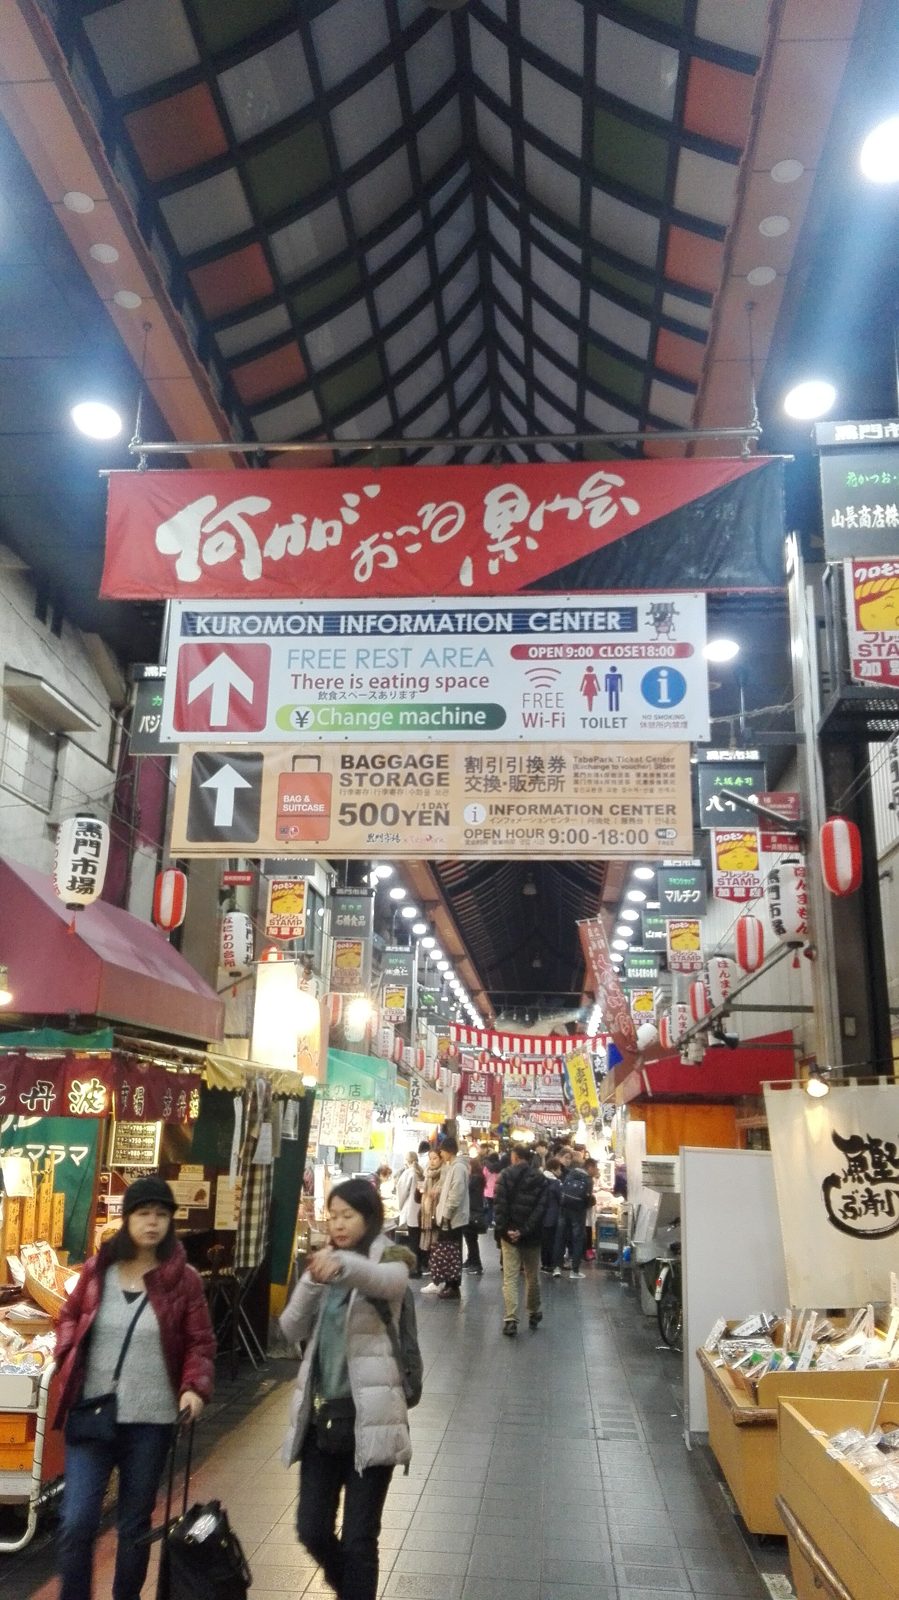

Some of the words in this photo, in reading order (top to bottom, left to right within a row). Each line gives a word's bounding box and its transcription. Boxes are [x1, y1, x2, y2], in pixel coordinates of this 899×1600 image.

[196, 615, 324, 635] KUROMON
[340, 612, 513, 635] INFORMATION
[528, 611, 621, 632] CENTER
[288, 648, 347, 669] FREE
[356, 648, 413, 669] REST
[420, 647, 494, 668] AREA
[528, 646, 562, 658] OPEN
[566, 646, 594, 658] 9:00
[291, 673, 344, 690] There
[350, 673, 363, 690] is
[368, 672, 430, 693] eating
[435, 676, 490, 692] space
[318, 691, 418, 701] 飲食スペースあります
[522, 692, 564, 709] FREE
[317, 707, 393, 730] Change
[399, 706, 487, 725] machine
[522, 711, 565, 728] Wi-Fi
[580, 717, 628, 729] TOILET
[340, 753, 450, 770] BAGGAGE
[463, 756, 567, 775] 割引引換券
[573, 755, 613, 763] TabePark
[339, 772, 450, 788] STORAGE
[283, 795, 302, 804] BAG
[303, 795, 310, 803] &
[429, 802, 450, 810] DAY
[282, 804, 325, 812] SUITCASE
[489, 804, 603, 816] INFORMATION
[609, 804, 677, 816] CENTER
[464, 829, 501, 839] OPEN
[506, 828, 545, 839] HOUR
[548, 828, 650, 845] 9:00-18:00
[66, 821, 103, 896] 黒門市場
[717, 878, 760, 887] STAMP
[664, 890, 701, 903] マルチク
